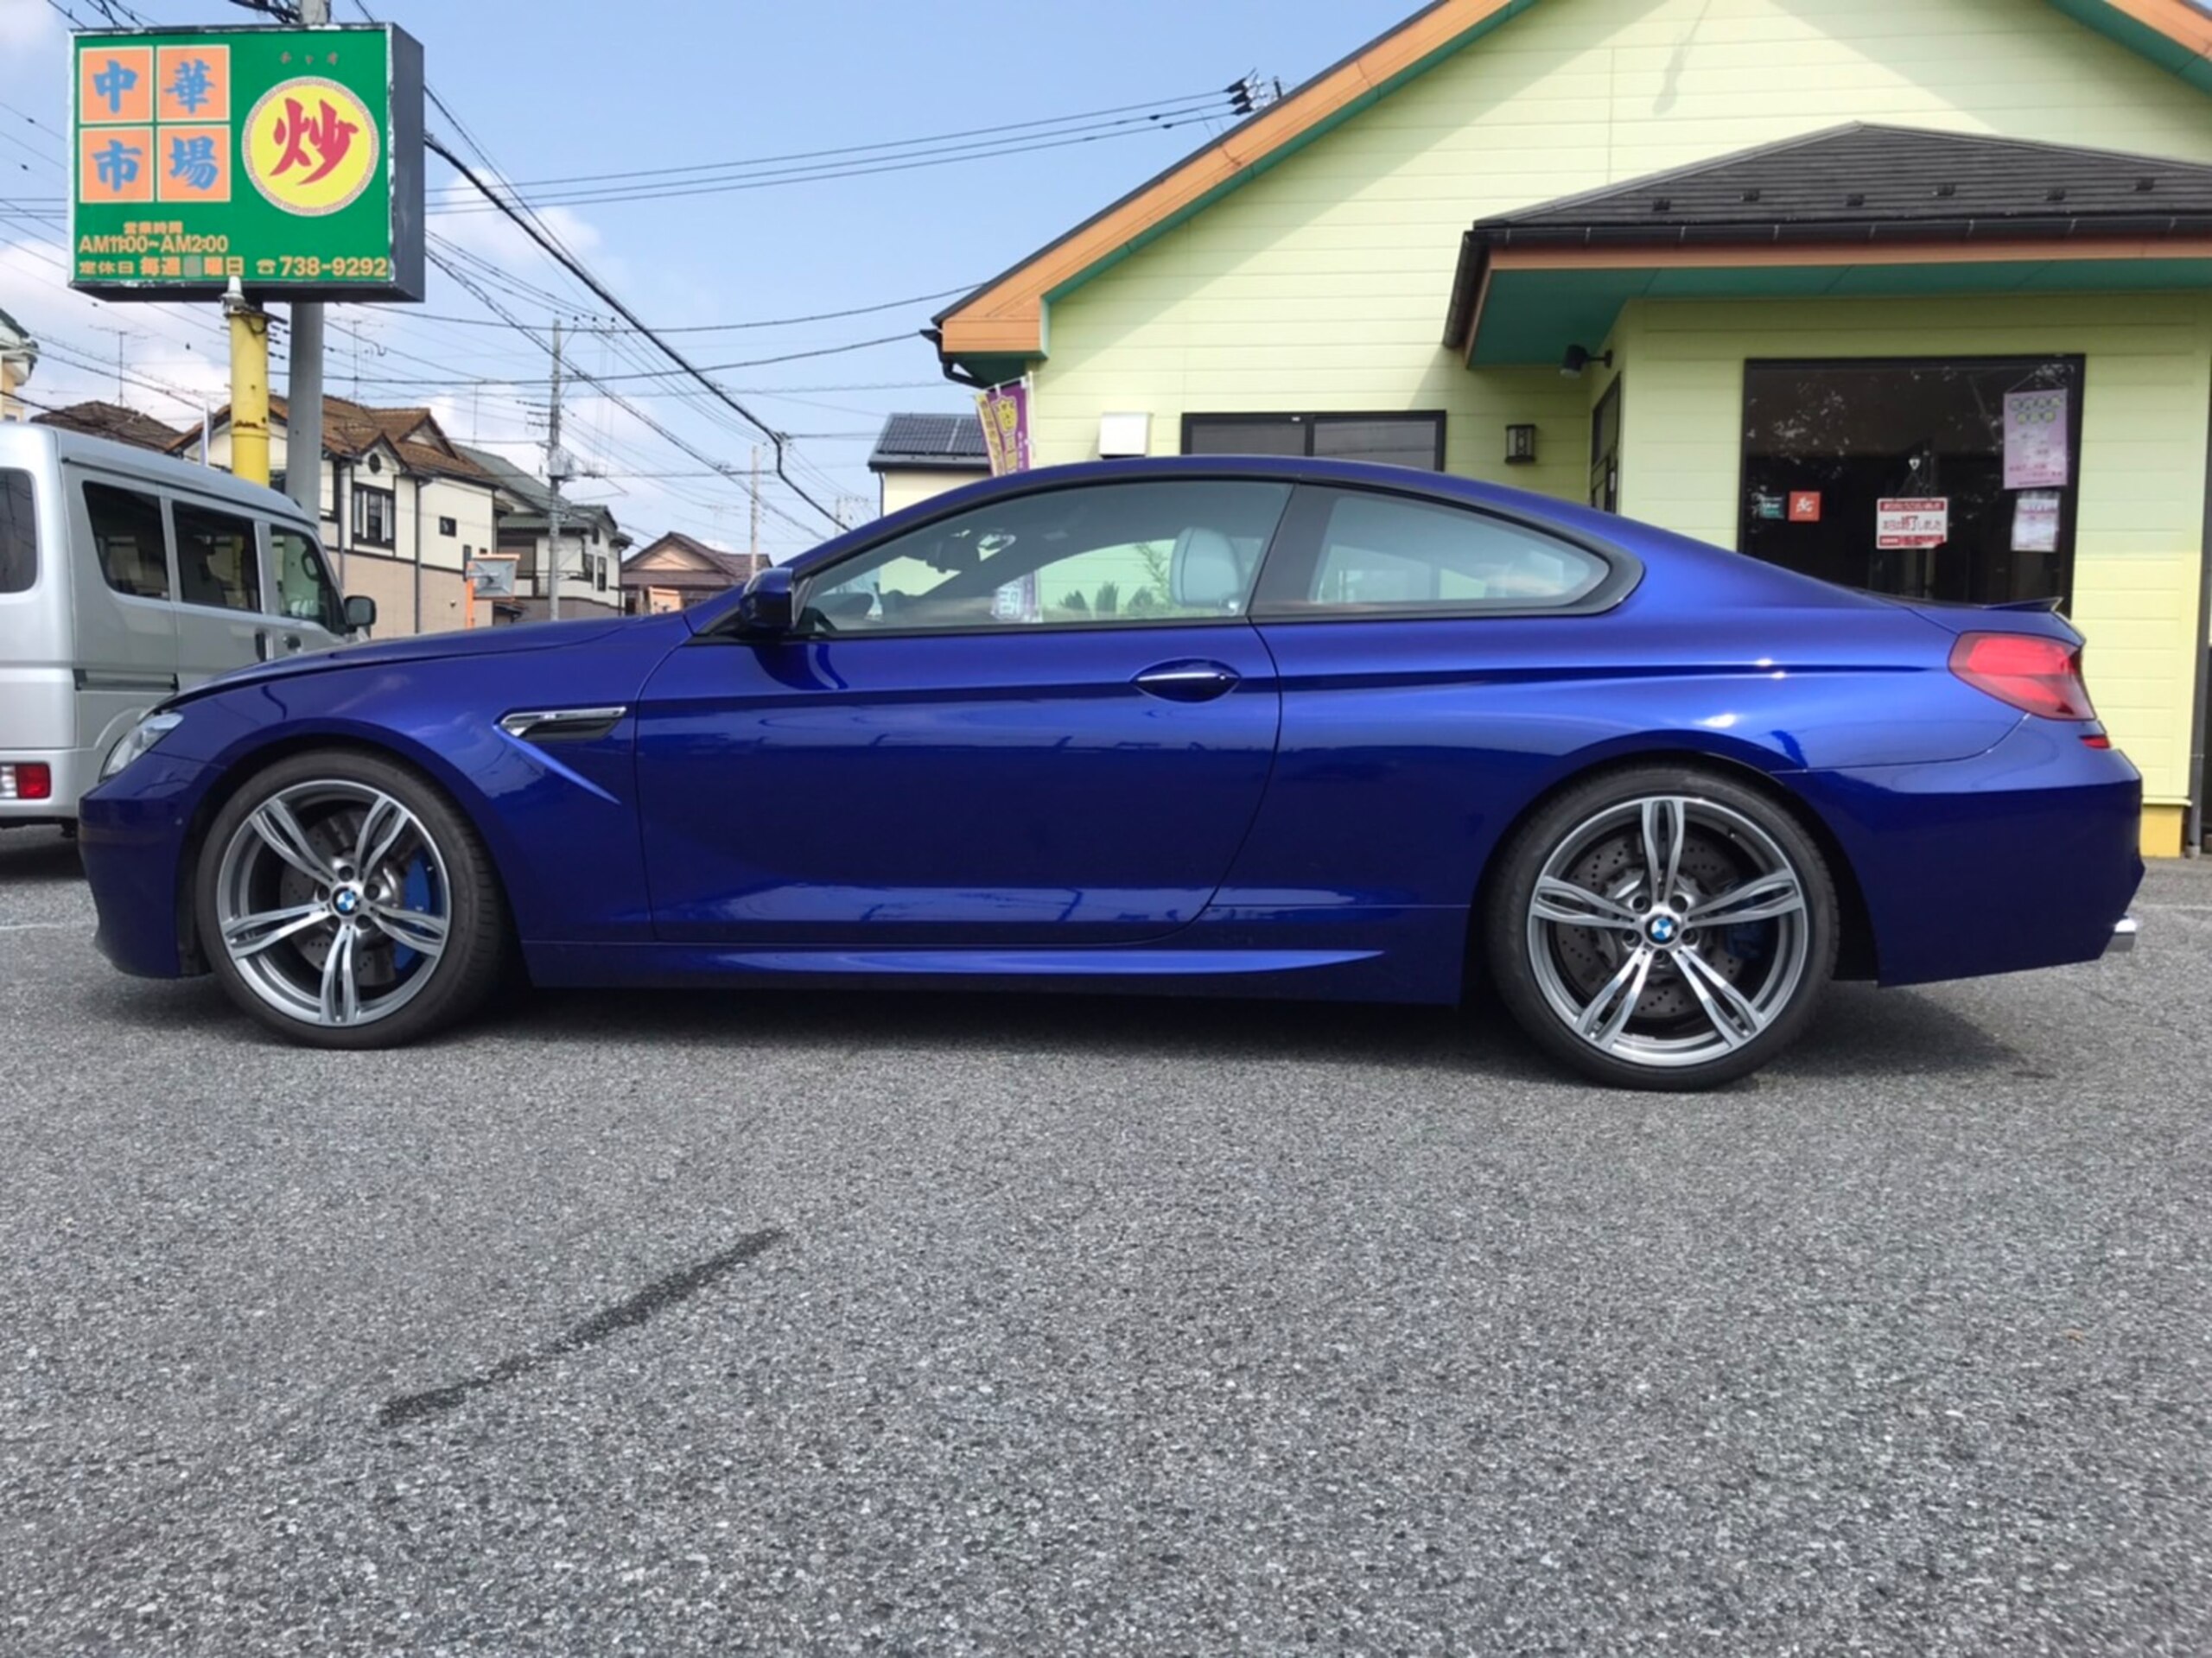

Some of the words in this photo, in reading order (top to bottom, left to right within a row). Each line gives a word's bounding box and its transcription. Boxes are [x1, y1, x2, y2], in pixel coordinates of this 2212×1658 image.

[92, 59, 216, 114] 中華
[92, 136, 219, 194] 市場
[269, 97, 359, 186] 炒
[141, 257, 244, 276] 毎週曜日
[278, 256, 387, 277] 738-9292
